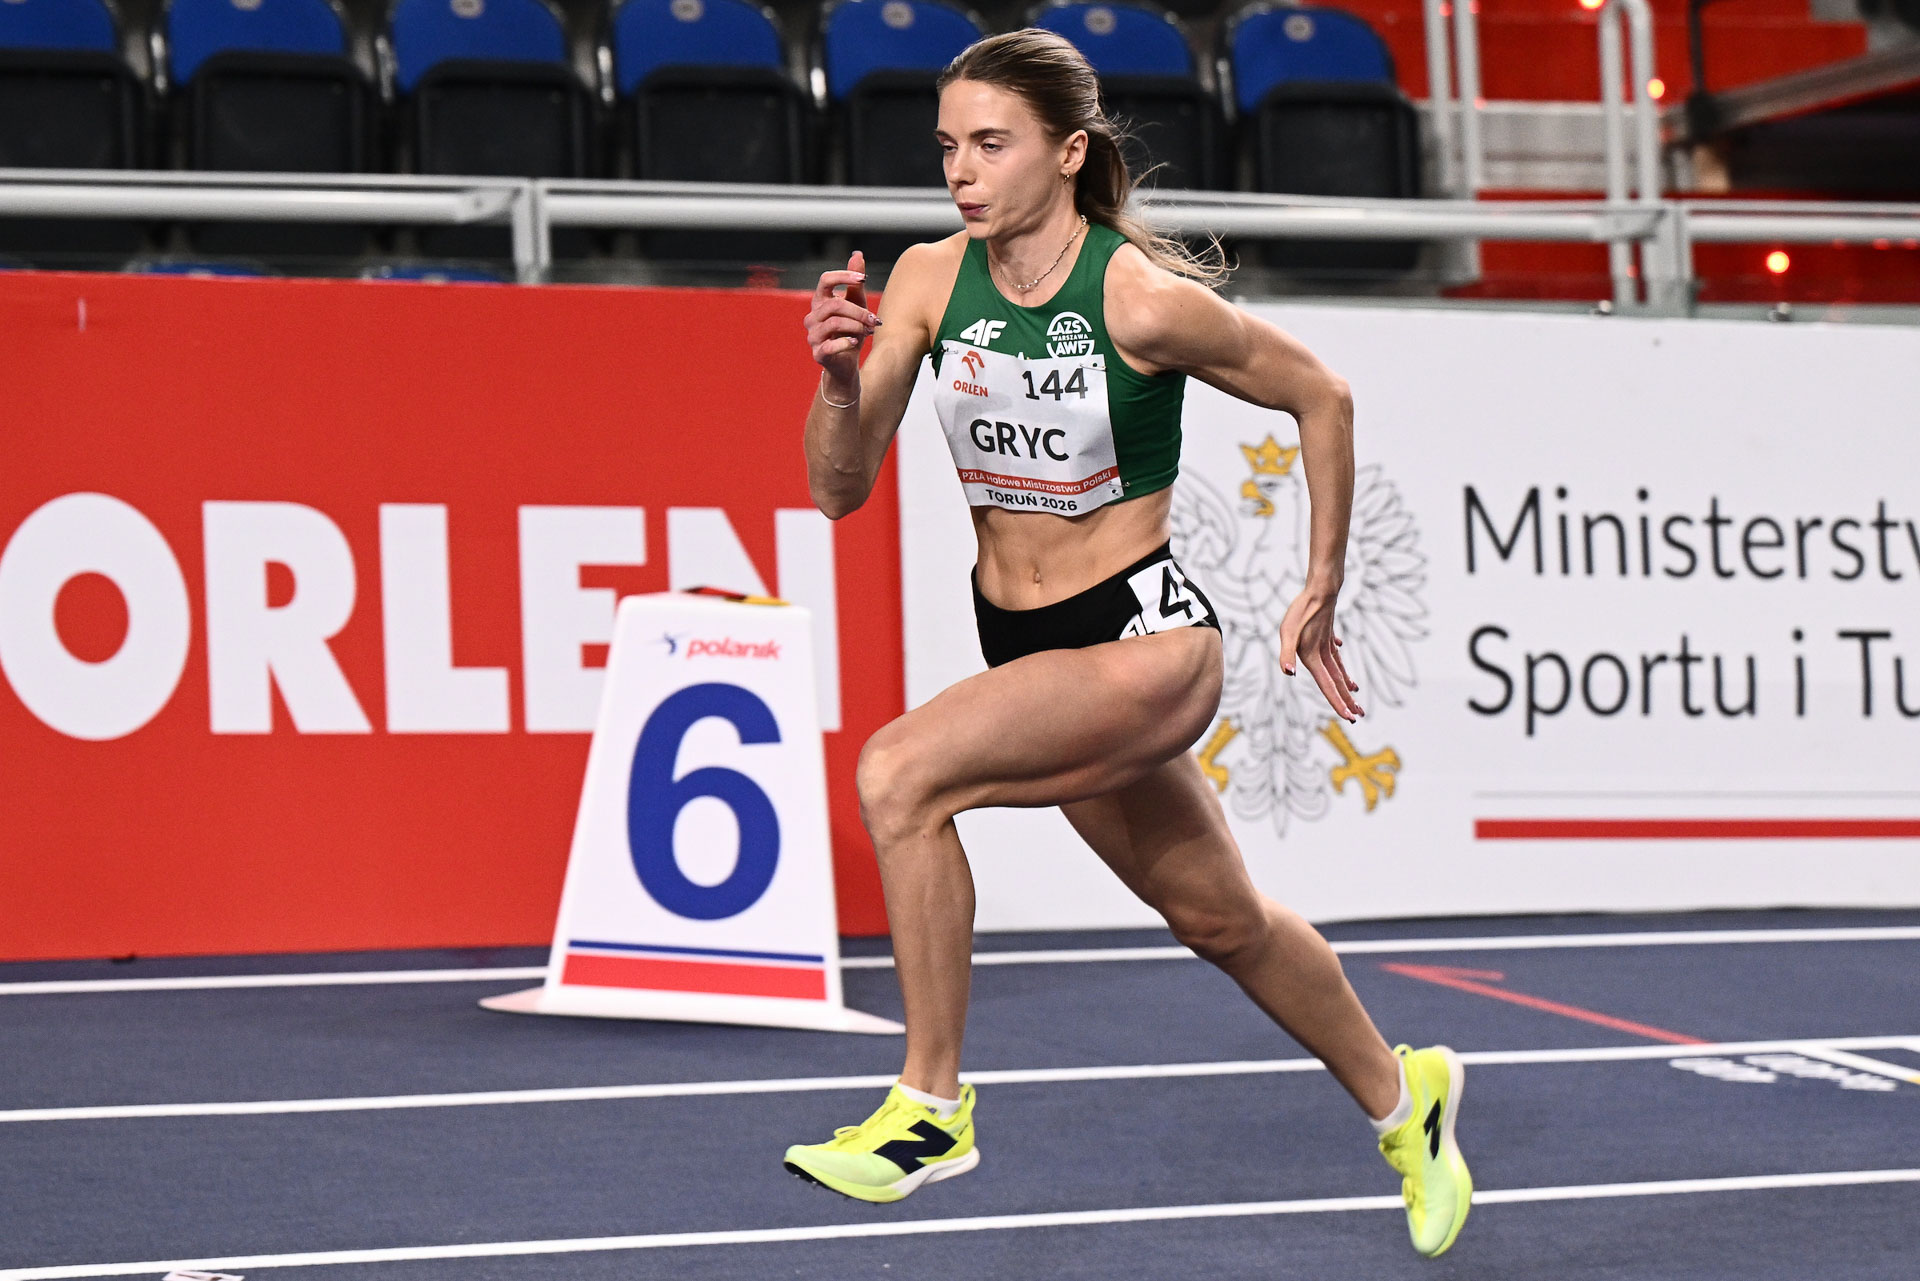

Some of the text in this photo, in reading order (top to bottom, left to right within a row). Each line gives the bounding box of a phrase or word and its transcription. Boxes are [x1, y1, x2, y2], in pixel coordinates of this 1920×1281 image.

[960, 318, 1007, 347] 4F
[1054, 320, 1082, 334] AZS
[1055, 340, 1088, 355] AWF
[953, 380, 988, 397] ORLEN
[1022, 367, 1088, 400] 144
[969, 418, 1069, 462] GRYC
[962, 470, 1111, 495] PZLA Halowe Mistrzostwa Polski
[985, 489, 1078, 512] TORUŃ 2026
[1159, 565, 1194, 619] 4
[686, 637, 781, 659] polanik
[1468, 624, 1756, 738] Sportu
[1792, 627, 1805, 718] i
[627, 681, 782, 923] 6
